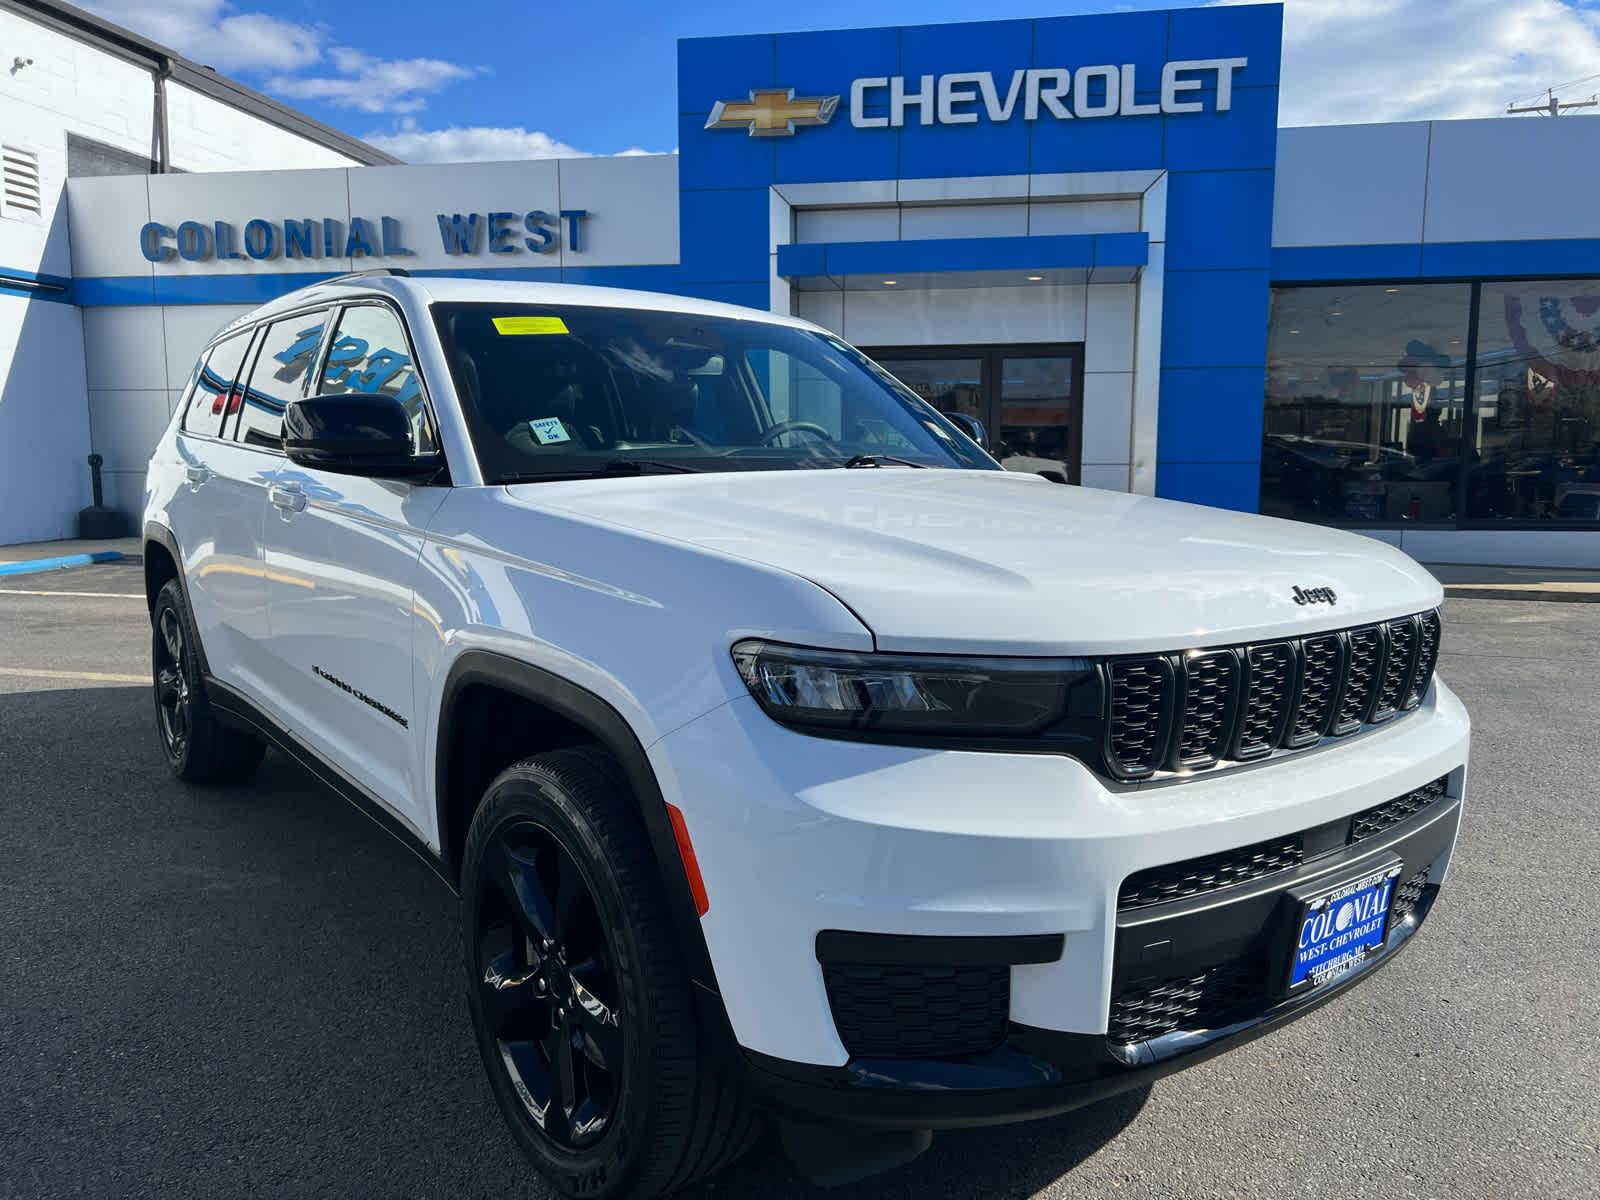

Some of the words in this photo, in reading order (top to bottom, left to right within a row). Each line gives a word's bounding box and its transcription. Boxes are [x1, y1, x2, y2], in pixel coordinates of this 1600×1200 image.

[850, 57, 1248, 128] CHEVROLET
[140, 215, 413, 263] COLONIAL
[436, 209, 588, 257] WEST
[1291, 584, 1337, 606] Jeep
[1298, 883, 1390, 949] COLONIAL
[1328, 916, 1384, 951] CHEVROLET
